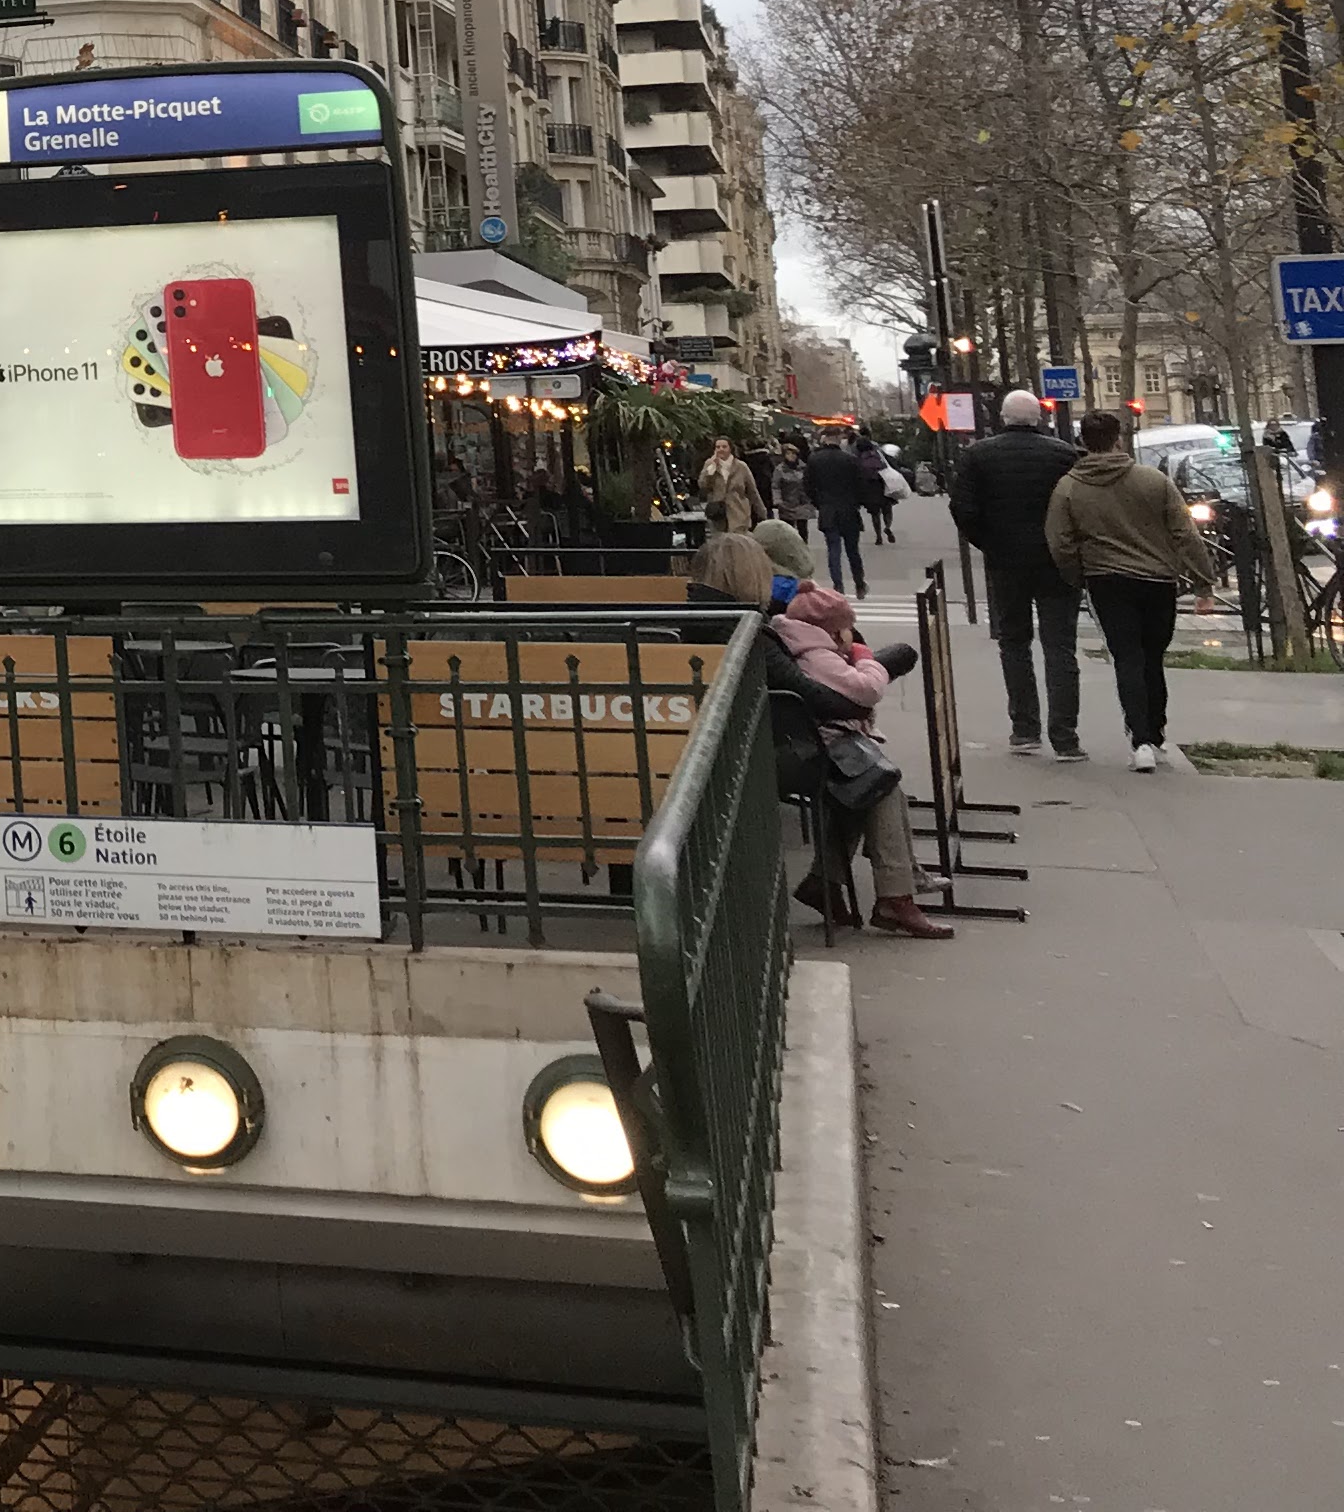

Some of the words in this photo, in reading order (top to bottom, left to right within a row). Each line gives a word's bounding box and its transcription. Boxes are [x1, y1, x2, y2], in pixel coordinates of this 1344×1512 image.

[469, 59, 479, 97] ancien
[23, 107, 49, 127] La
[56, 96, 222, 125] Motte-Picquet
[24, 127, 120, 152] Grenelle
[476, 102, 501, 216] HealthCity
[1286, 286, 1344, 314] TAX
[8, 363, 79, 383] iPhone
[81, 362, 98, 380] 11
[1044, 377, 1078, 390] TAXIS
[94, 822, 147, 844] Étoile
[58, 831, 75, 855] 6
[95, 848, 158, 865] Nation
[49, 877, 70, 887] Pour
[73, 878, 98, 888] cette
[157, 882, 167, 891] To
[169, 884, 194, 892] access
[196, 884, 211, 892] this
[49, 888, 83, 898] utiliser
[85, 888, 123, 899] l'entrée
[157, 893, 183, 901] please
[200, 894, 214, 902] the
[215, 896, 251, 904] entrance
[266, 887, 280, 895] Per
[282, 888, 317, 896] accedere
[326, 890, 355, 898] questa
[50, 899, 71, 908] sous
[73, 898, 83, 908] le
[158, 903, 182, 911] below
[183, 904, 197, 912] the
[291, 898, 297, 906] si
[299, 899, 322, 908] prega
[324, 899, 333, 907] di
[51, 909, 62, 918] 50
[64, 911, 74, 919] m
[76, 909, 115, 920] derrière
[116, 913, 140, 921] vous
[180, 913, 208, 923] behind
[267, 908, 305, 916] utilizzare
[343, 910, 366, 919] sotto
